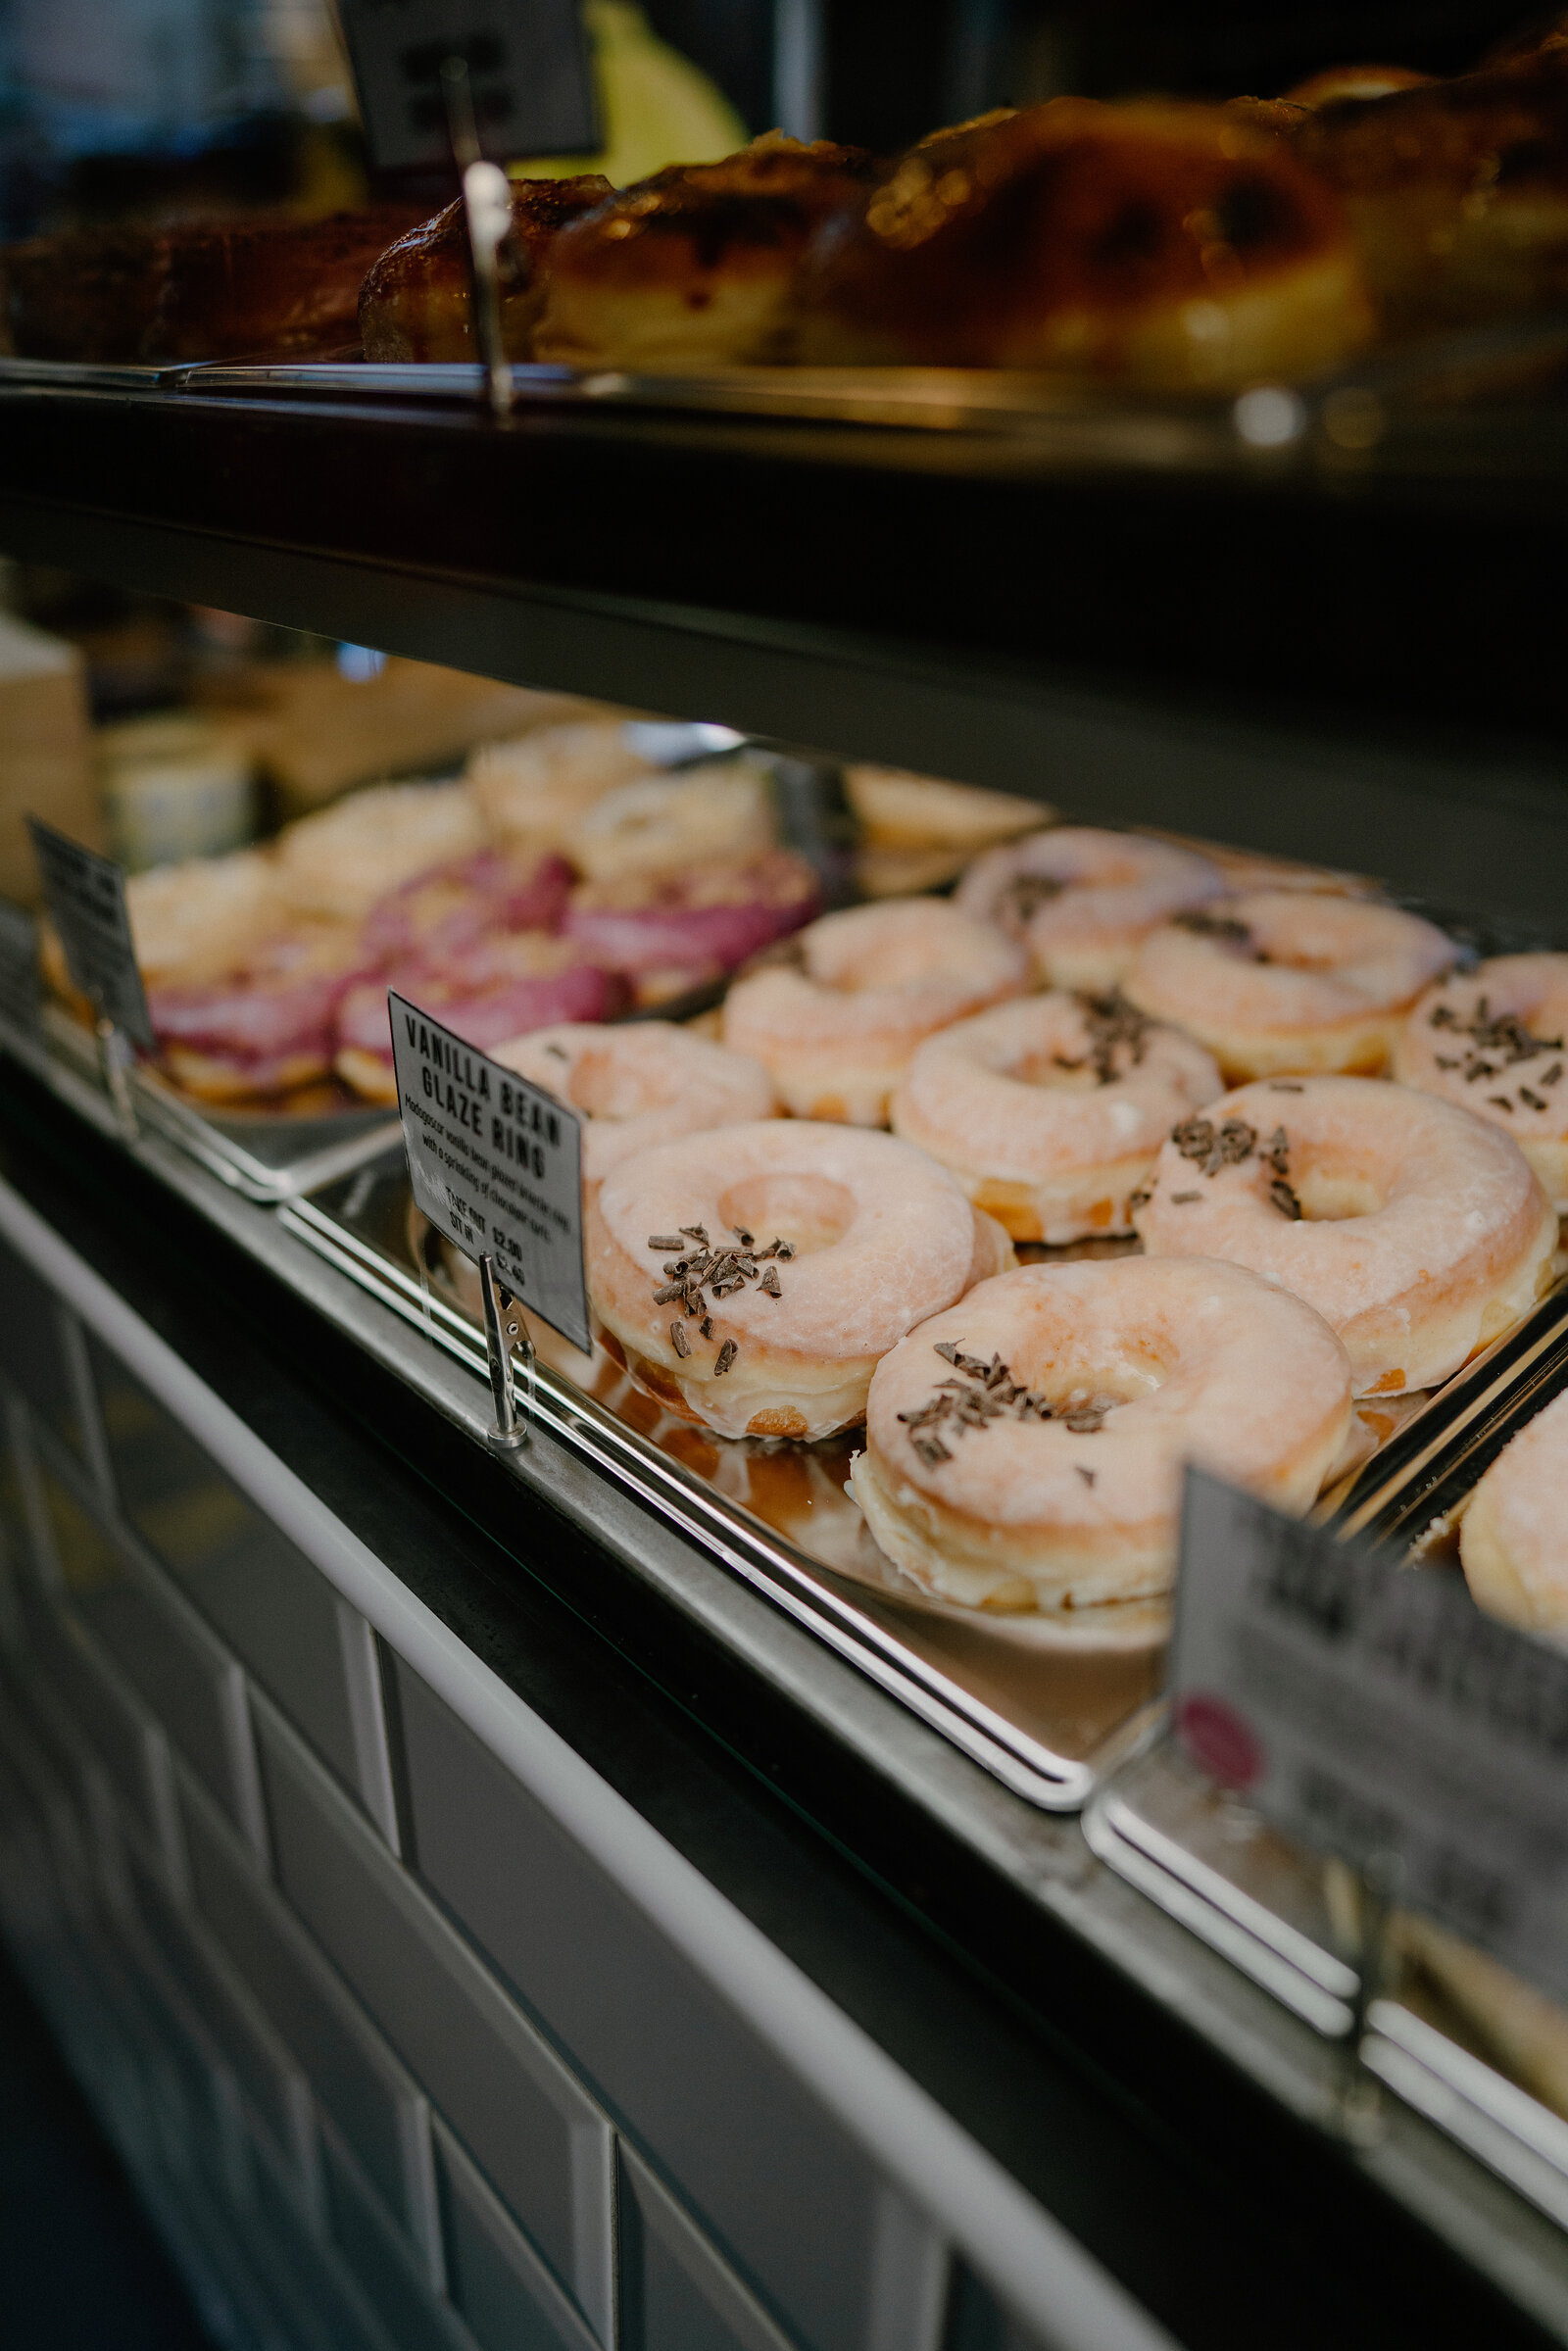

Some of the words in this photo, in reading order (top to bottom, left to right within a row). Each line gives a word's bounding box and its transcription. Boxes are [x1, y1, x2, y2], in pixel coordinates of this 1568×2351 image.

[406, 1013, 491, 1102] VANILLA
[500, 1081, 562, 1149] BEAN
[405, 1093, 444, 1135] Madagascar
[446, 1130, 469, 1156] vanilla
[421, 1065, 483, 1138] GLAZE
[492, 1116, 546, 1180] RING
[422, 1133, 438, 1154] with
[438, 1147, 444, 1160] a
[444, 1151, 479, 1193] sprinkling
[450, 1210, 464, 1235] SIT
